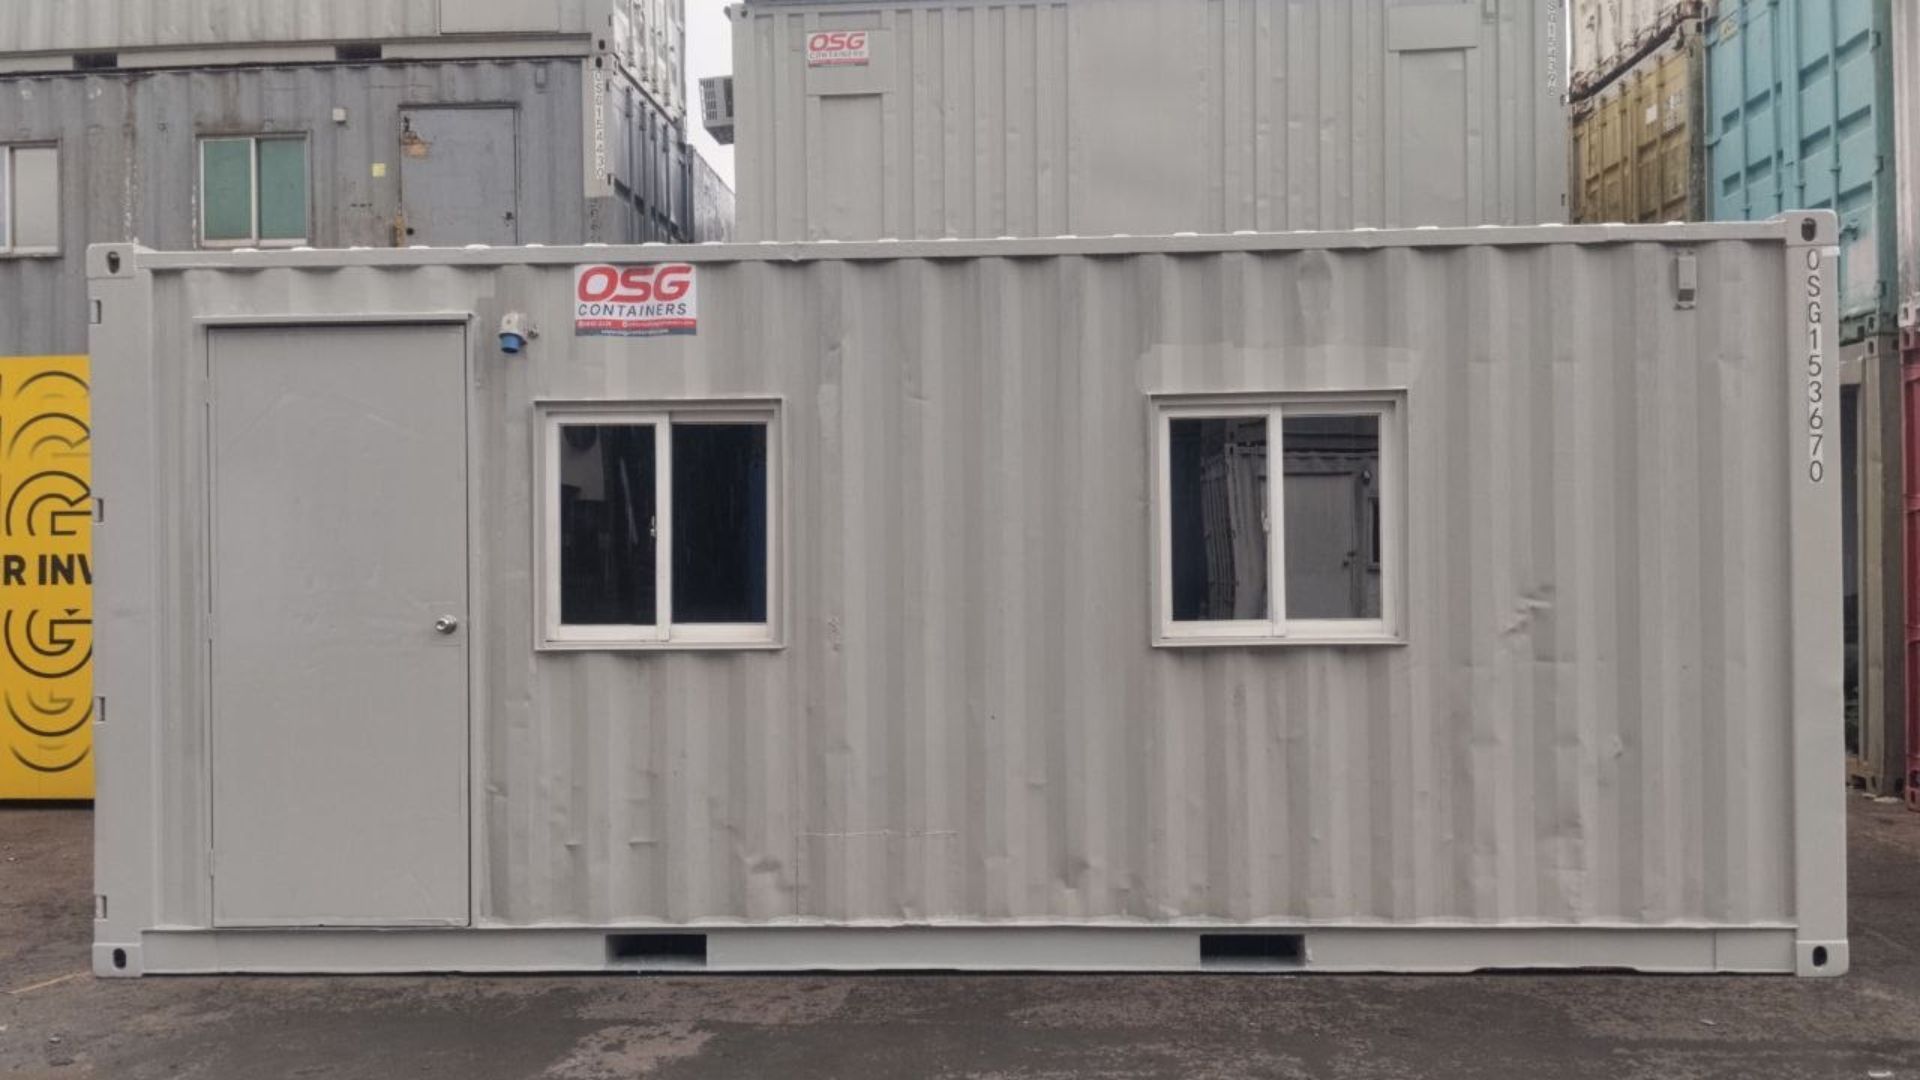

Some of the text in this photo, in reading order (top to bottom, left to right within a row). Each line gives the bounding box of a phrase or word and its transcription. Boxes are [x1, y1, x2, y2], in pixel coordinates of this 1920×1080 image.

[809, 32, 866, 51] OSG
[578, 265, 693, 303] OSG
[578, 303, 687, 317] CONTAINERS
[1806, 249, 1823, 482] OSG153670
